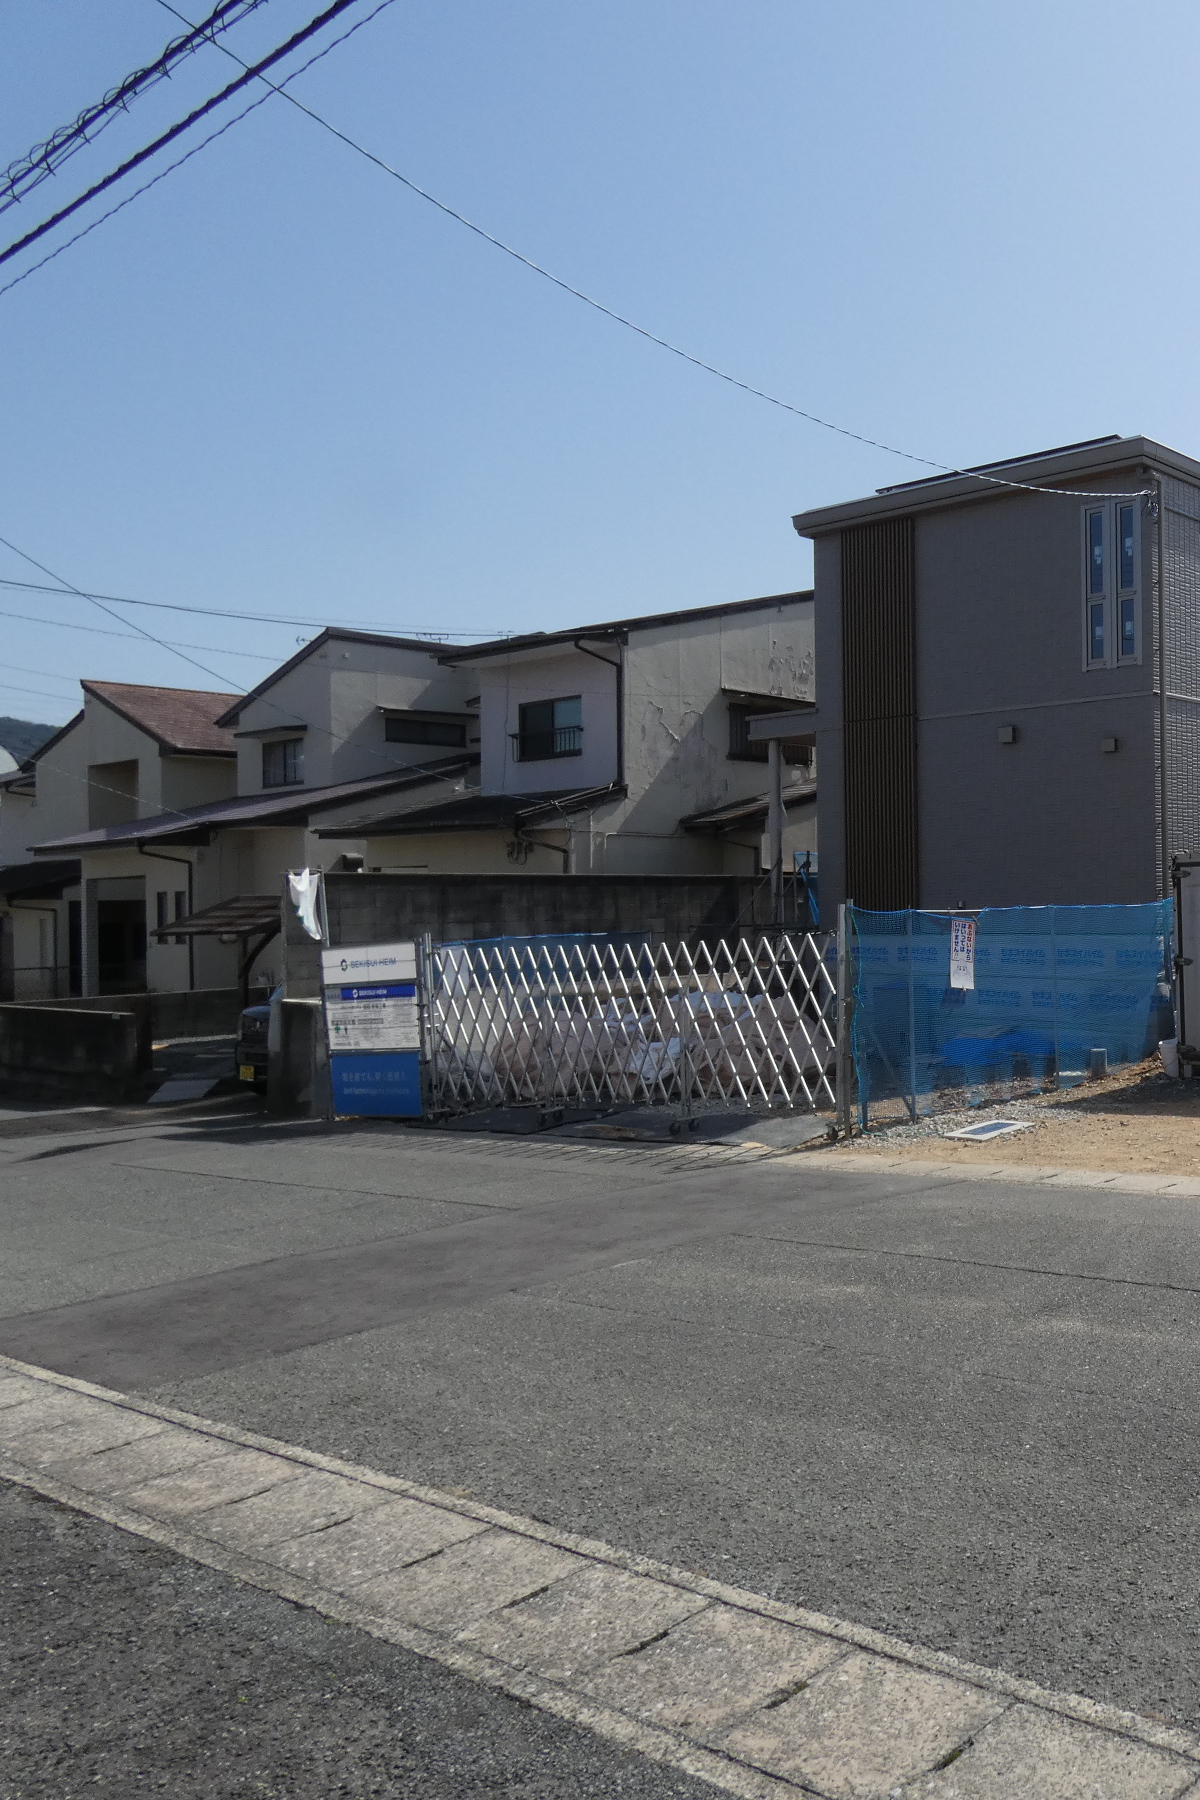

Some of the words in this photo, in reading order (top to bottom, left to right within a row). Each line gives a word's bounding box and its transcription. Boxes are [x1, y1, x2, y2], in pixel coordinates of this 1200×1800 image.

[959, 922, 967, 953] はいっては
[966, 923, 974, 961] あぶないから
[350, 960, 378, 968] SEKISUI
[378, 957, 397, 965] HEIM
